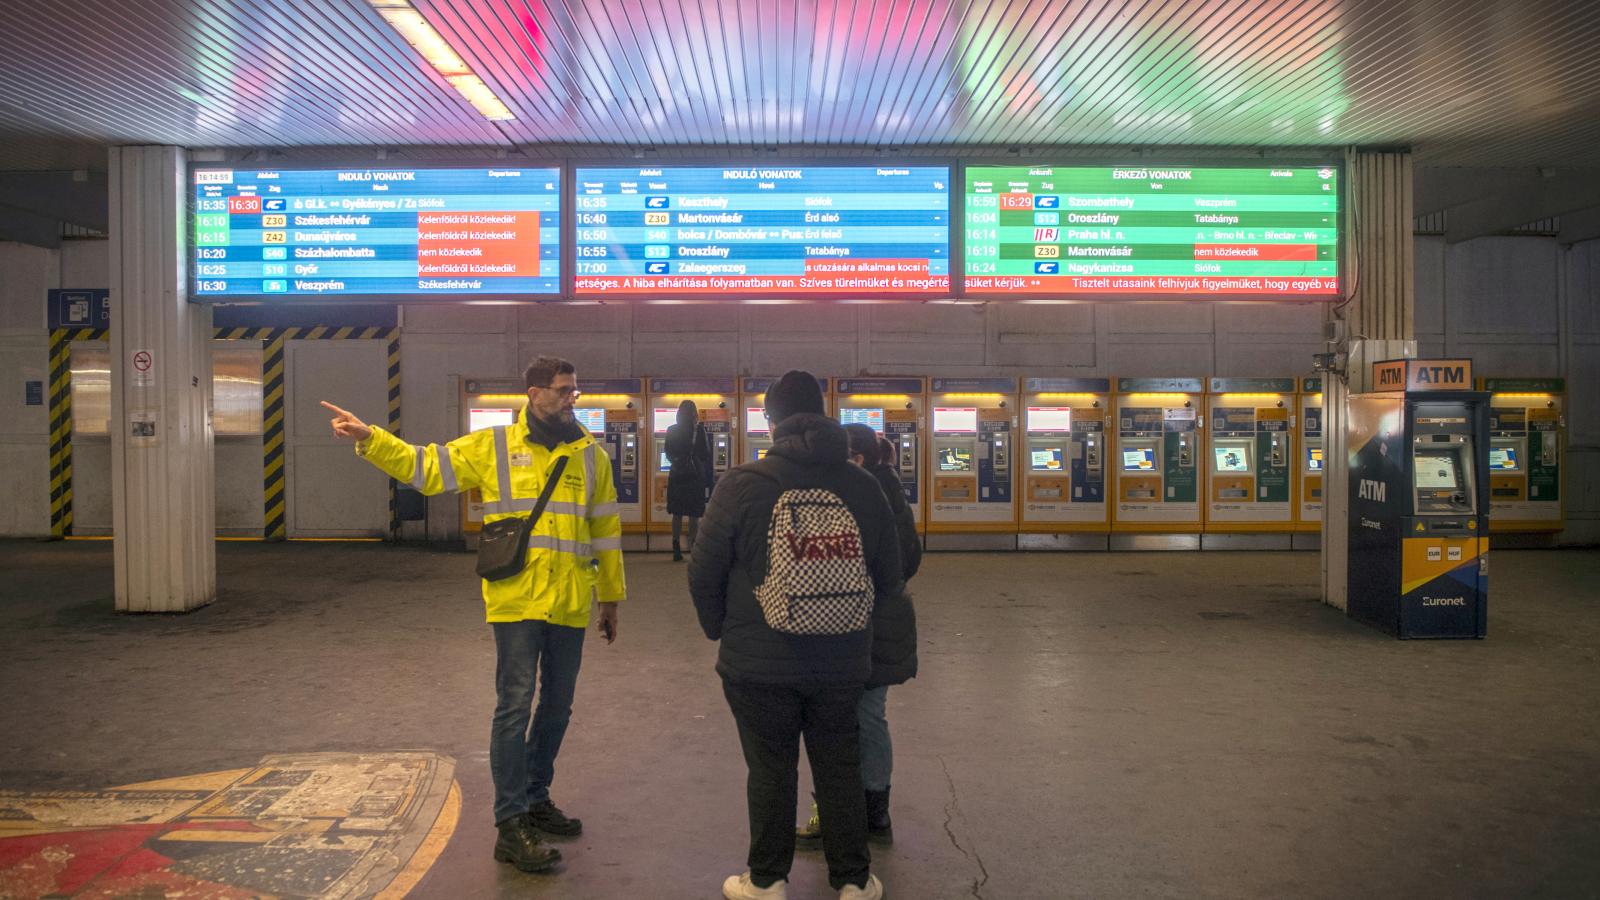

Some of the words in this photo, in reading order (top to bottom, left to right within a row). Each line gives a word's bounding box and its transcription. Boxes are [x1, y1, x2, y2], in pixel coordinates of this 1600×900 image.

[338, 172, 372, 181] INDULÓ
[373, 172, 415, 180] VONATOK
[723, 169, 757, 179] INDULÓ
[759, 170, 802, 178] VONATOK
[1113, 169, 1147, 179] ÉRKEZŐ
[1149, 171, 1192, 179] VONATOK
[1042, 182, 1053, 190] Zug
[198, 201, 226, 210] 15:35
[230, 201, 258, 210] 16:30
[418, 199, 445, 208] Siófok
[577, 198, 607, 207] 16:35
[678, 198, 728, 209] Keszthely
[805, 197, 832, 206] Siófok
[968, 197, 996, 206] 15:59
[1002, 197, 1031, 206] 16:29
[1068, 197, 1134, 208] Szombathely
[1194, 198, 1236, 208] Veszprém
[198, 217, 225, 225] 16:10
[295, 215, 371, 225] Székesfehérvár
[418, 215, 468, 224] Kelenföldről
[470, 215, 516, 224] közlekedik!
[577, 214, 607, 223] 16:40
[678, 213, 742, 223] Martonvásár
[805, 212, 819, 222] Érd
[821, 212, 839, 222] alsó
[968, 213, 996, 222] 16:04
[1068, 213, 1119, 225] Oroszlány
[1194, 214, 1238, 224] Tatabánya
[198, 233, 225, 242] 16:15
[295, 231, 357, 244] Dunaújváros
[418, 232, 468, 240] Kelenföldről
[470, 232, 516, 240] közlekedik!
[577, 231, 607, 240] 16:50
[715, 229, 766, 239] Dombóvár
[805, 228, 819, 238] Érd
[967, 229, 996, 238] 16:14
[1068, 230, 1098, 239] Praha
[1214, 231, 1233, 239] Brno
[198, 249, 226, 258] 16:20
[295, 248, 375, 257] Százhalombatta
[439, 248, 482, 256] közlekedik
[577, 247, 607, 256] 16:55
[647, 248, 666, 256] S12
[678, 246, 729, 257] Oroszlány
[805, 246, 849, 256] Tatabánya
[967, 246, 996, 255] 16:19
[1068, 246, 1132, 256] Martonvásár
[1215, 247, 1258, 256] közlekedik
[198, 265, 226, 274] 16:25
[295, 264, 319, 276] Győr
[418, 264, 468, 272] Kelenföldről
[470, 264, 516, 272] közlekedik!
[577, 263, 607, 272] 17:00
[678, 263, 746, 274] Zalaegerszeg
[814, 262, 855, 271] utazására
[858, 263, 895, 271] alkalmas
[898, 263, 921, 271] kocsi
[967, 263, 996, 272] 16:24
[1068, 262, 1133, 274] Nagykanizsa
[1194, 264, 1221, 272] Siófok
[198, 282, 226, 290] 16:30
[295, 280, 344, 291] Veszprém
[418, 280, 482, 289] Székesfehérvár
[624, 279, 630, 287] A
[633, 278, 654, 288] hiba
[658, 278, 707, 288] elhárítása
[710, 278, 773, 290] folyamatban
[776, 279, 796, 287] van.
[800, 278, 832, 287] Szíves
[835, 278, 889, 287] türelmüket
[892, 277, 903, 287] és
[965, 278, 992, 287] süket
[995, 278, 1028, 289] kérjük.
[1072, 278, 1110, 288] Tisztelt
[1113, 278, 1155, 288] utasaink
[1159, 278, 1199, 290] felhívjuk
[1202, 278, 1262, 290] figyelmüket,
[1265, 278, 1289, 290] hogy
[1292, 279, 1321, 290] egyéb
[1325, 279, 1336, 289] vá
[1380, 368, 1402, 384] ATM
[1416, 366, 1464, 384] ATM
[1358, 479, 1386, 502] ATM
[783, 532, 859, 560] VANS
[1422, 596, 1465, 606] Euronet
